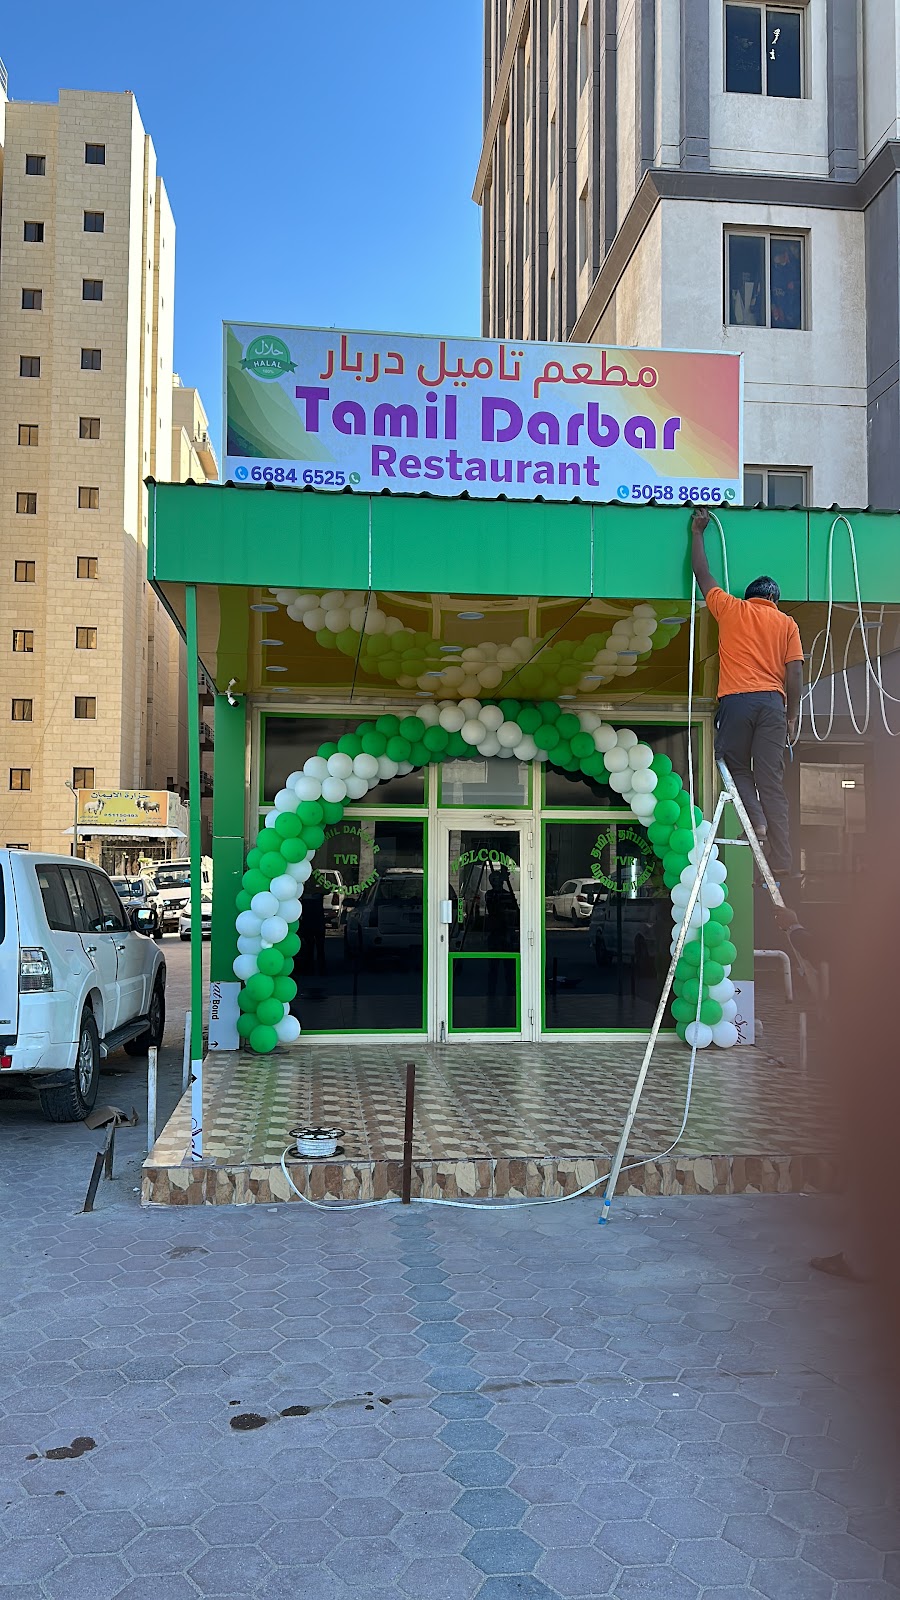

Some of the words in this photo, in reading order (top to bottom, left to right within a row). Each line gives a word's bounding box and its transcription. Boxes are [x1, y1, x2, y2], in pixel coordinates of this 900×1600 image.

[254, 339, 284, 356] حلال
[319, 335, 404, 383] دربار
[253, 360, 282, 369] HALAL
[417, 341, 525, 387] تاميل
[533, 350, 659, 399] مطعم
[295, 385, 457, 440] Tamil
[481, 396, 681, 450] Darbar
[250, 466, 298, 483] 6684
[302, 469, 346, 486] 6525
[371, 444, 600, 486] Restaurant
[631, 484, 674, 500] 5058
[678, 486, 722, 502] 8666
[343, 825, 380, 854] DARBAR
[333, 854, 358, 865] TVR
[451, 848, 517, 874] WELCOME
[612, 856, 635, 866] TVR
[211, 999, 221, 1020] Bond
